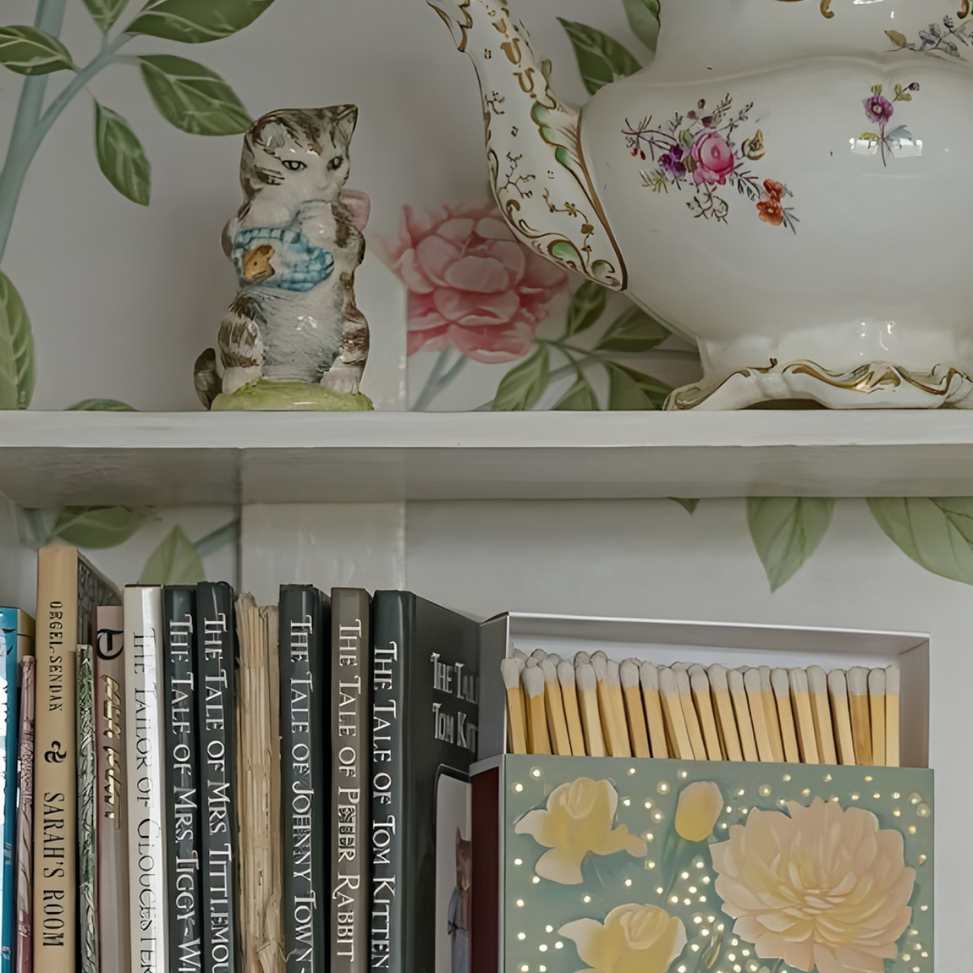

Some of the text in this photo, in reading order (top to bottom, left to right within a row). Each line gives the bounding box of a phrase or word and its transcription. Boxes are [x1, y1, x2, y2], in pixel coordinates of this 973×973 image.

[133, 627, 157, 674] THE
[169, 613, 194, 663] THE
[203, 613, 228, 661] THE
[290, 615, 313, 663] THE
[430, 652, 453, 694] THE
[171, 672, 194, 735] TALE
[205, 669, 228, 731] TALE
[290, 671, 314, 733] TALE
[432, 702, 454, 744] TOM
[135, 682, 157, 770] TAILOR
[173, 744, 192, 776] OF
[206, 740, 225, 772] OF
[292, 743, 311, 775] OF
[136, 777, 155, 808] OF
[333, 619, 362, 963] THE TALE OF PETER RABBIT
[371, 641, 398, 969] THE TALE OF TOM KITTEN
[291, 780, 314, 882] JOHNNY
[42, 792, 65, 947] SARAH'S ROOM
